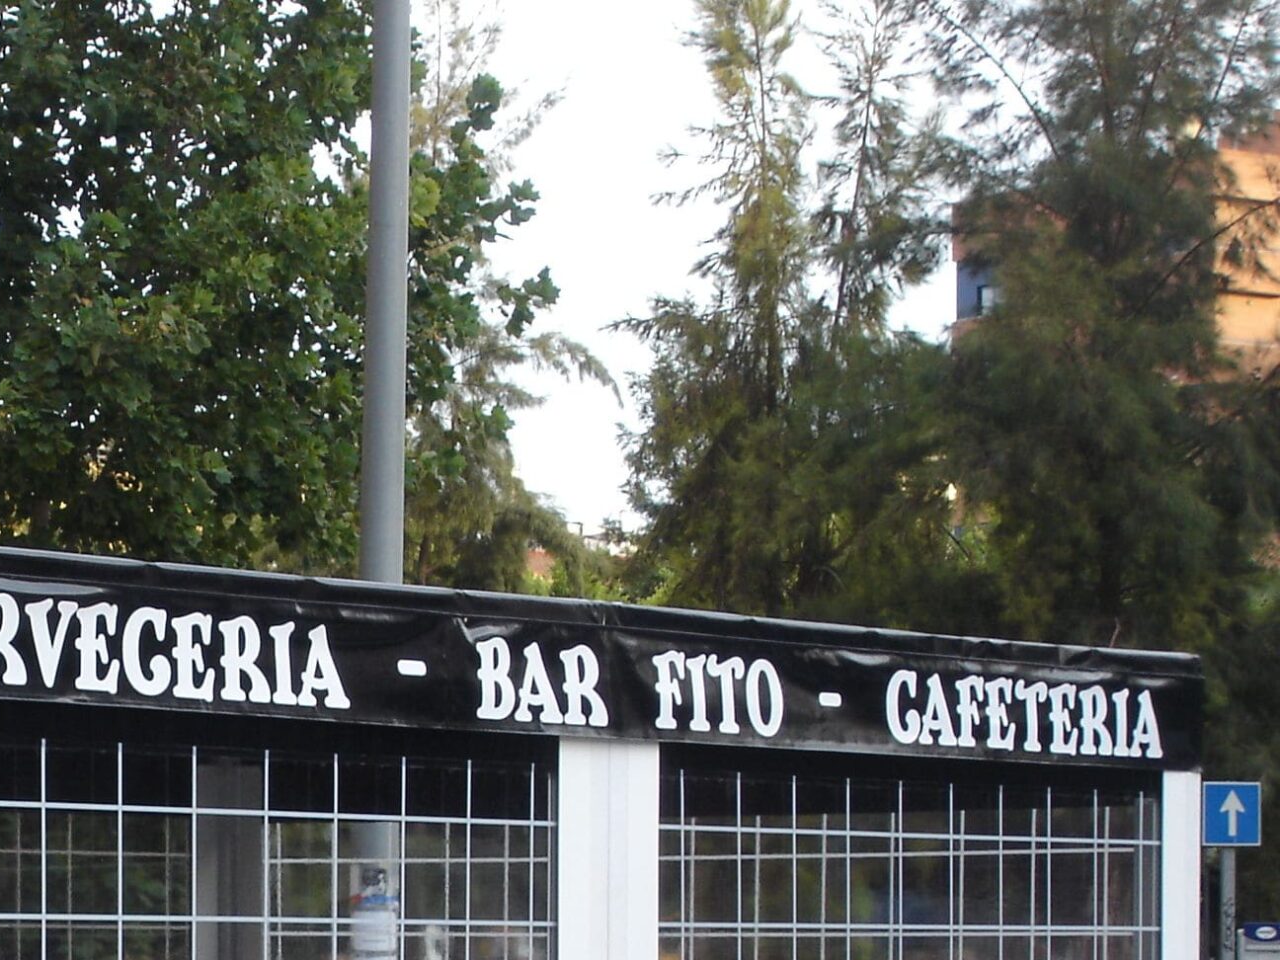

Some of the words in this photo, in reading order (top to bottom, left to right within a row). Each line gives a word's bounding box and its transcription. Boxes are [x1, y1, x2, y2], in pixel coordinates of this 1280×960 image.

[475, 636, 609, 727] BAR
[651, 649, 784, 738] FITO
[885, 669, 1164, 759] CAFETERIA
